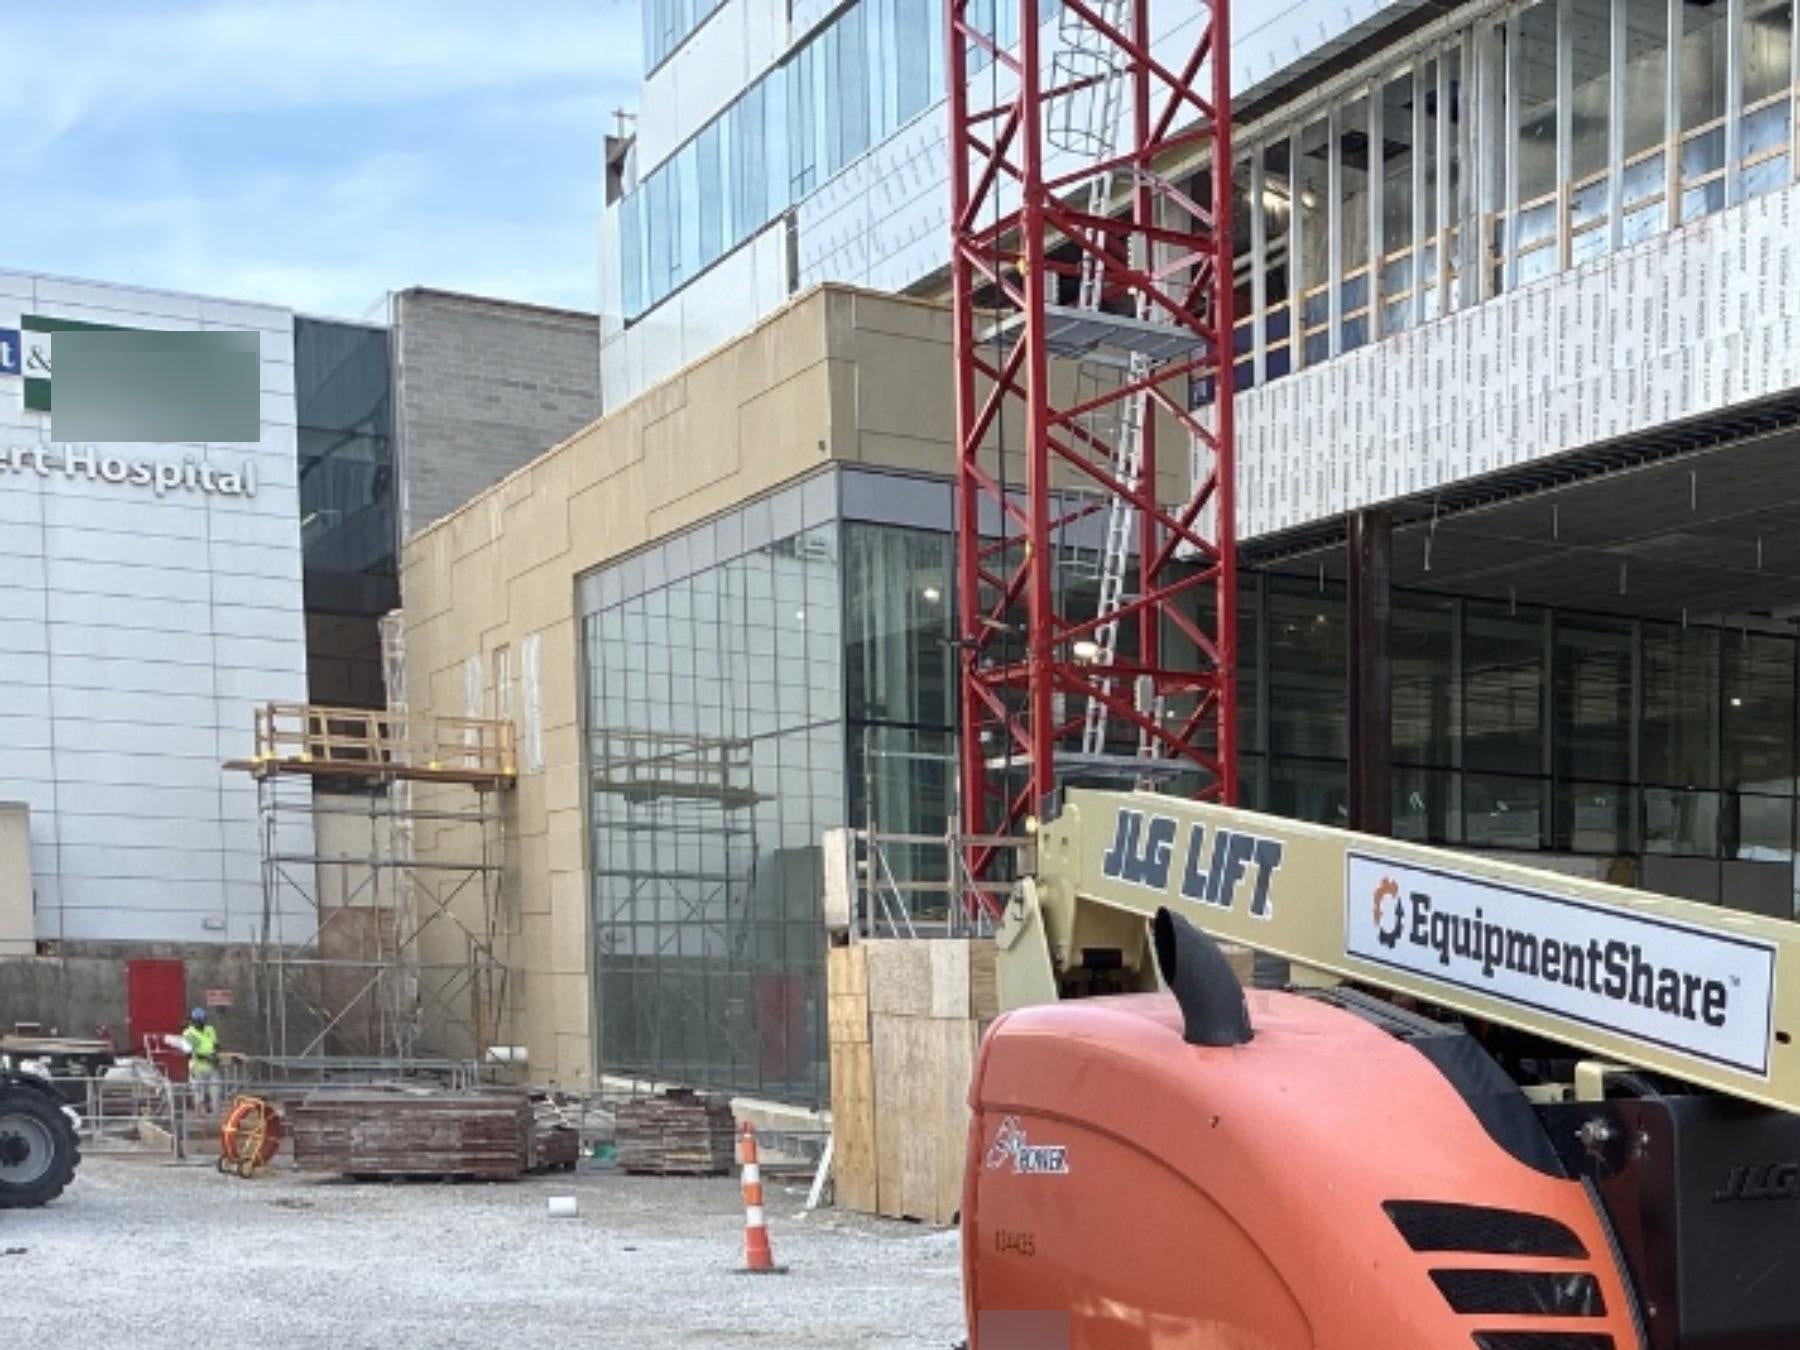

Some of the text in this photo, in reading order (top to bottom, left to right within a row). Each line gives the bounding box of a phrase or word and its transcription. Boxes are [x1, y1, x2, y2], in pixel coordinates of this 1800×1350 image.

[64, 443, 258, 499] Hospital
[1102, 807, 1287, 921] JLG LIFT
[1408, 891, 1727, 1027] EquipmentShare
[1712, 1163, 1798, 1202] JLG
